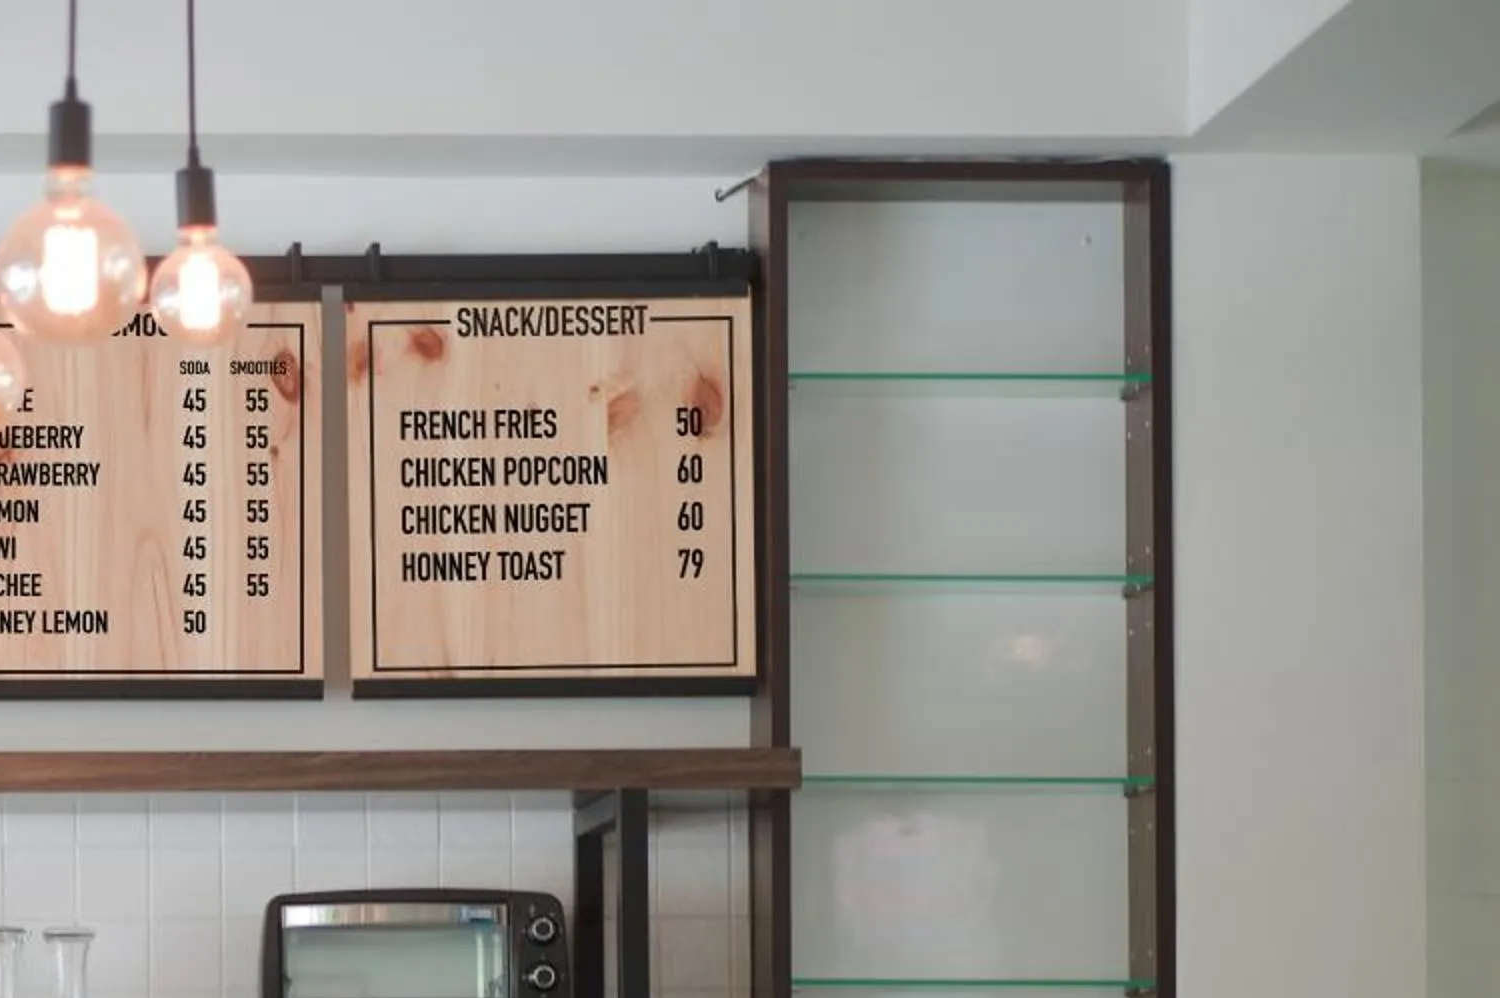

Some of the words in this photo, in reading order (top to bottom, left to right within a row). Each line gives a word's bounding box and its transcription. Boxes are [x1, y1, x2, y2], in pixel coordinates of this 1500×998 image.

[458, 306, 648, 337] SNACK/DESSERT
[180, 361, 210, 374] SODA
[183, 389, 205, 412] 45
[246, 389, 268, 412] 55
[401, 410, 485, 440] FRENCH
[495, 410, 556, 438] FRIES
[677, 406, 703, 436] 50
[183, 426, 205, 448] 45
[247, 426, 268, 448] 55
[184, 463, 206, 485] 45
[247, 463, 268, 486] 55
[402, 458, 495, 487] CHICKEN
[504, 456, 607, 486] POPCORN
[678, 455, 702, 483] 60
[184, 500, 205, 522] 45
[248, 500, 268, 522] 55
[402, 505, 496, 534] CHICKEN
[505, 504, 590, 533] NUGGET
[678, 502, 703, 530] 60
[184, 537, 205, 560] 45
[247, 537, 268, 559] 55
[403, 552, 490, 581] HONNEY
[497, 551, 564, 580] TOAST
[679, 549, 703, 578] 79
[184, 574, 205, 596] 45
[247, 574, 268, 596] 55
[43, 611, 107, 633] LEMON
[184, 611, 205, 633] 50
